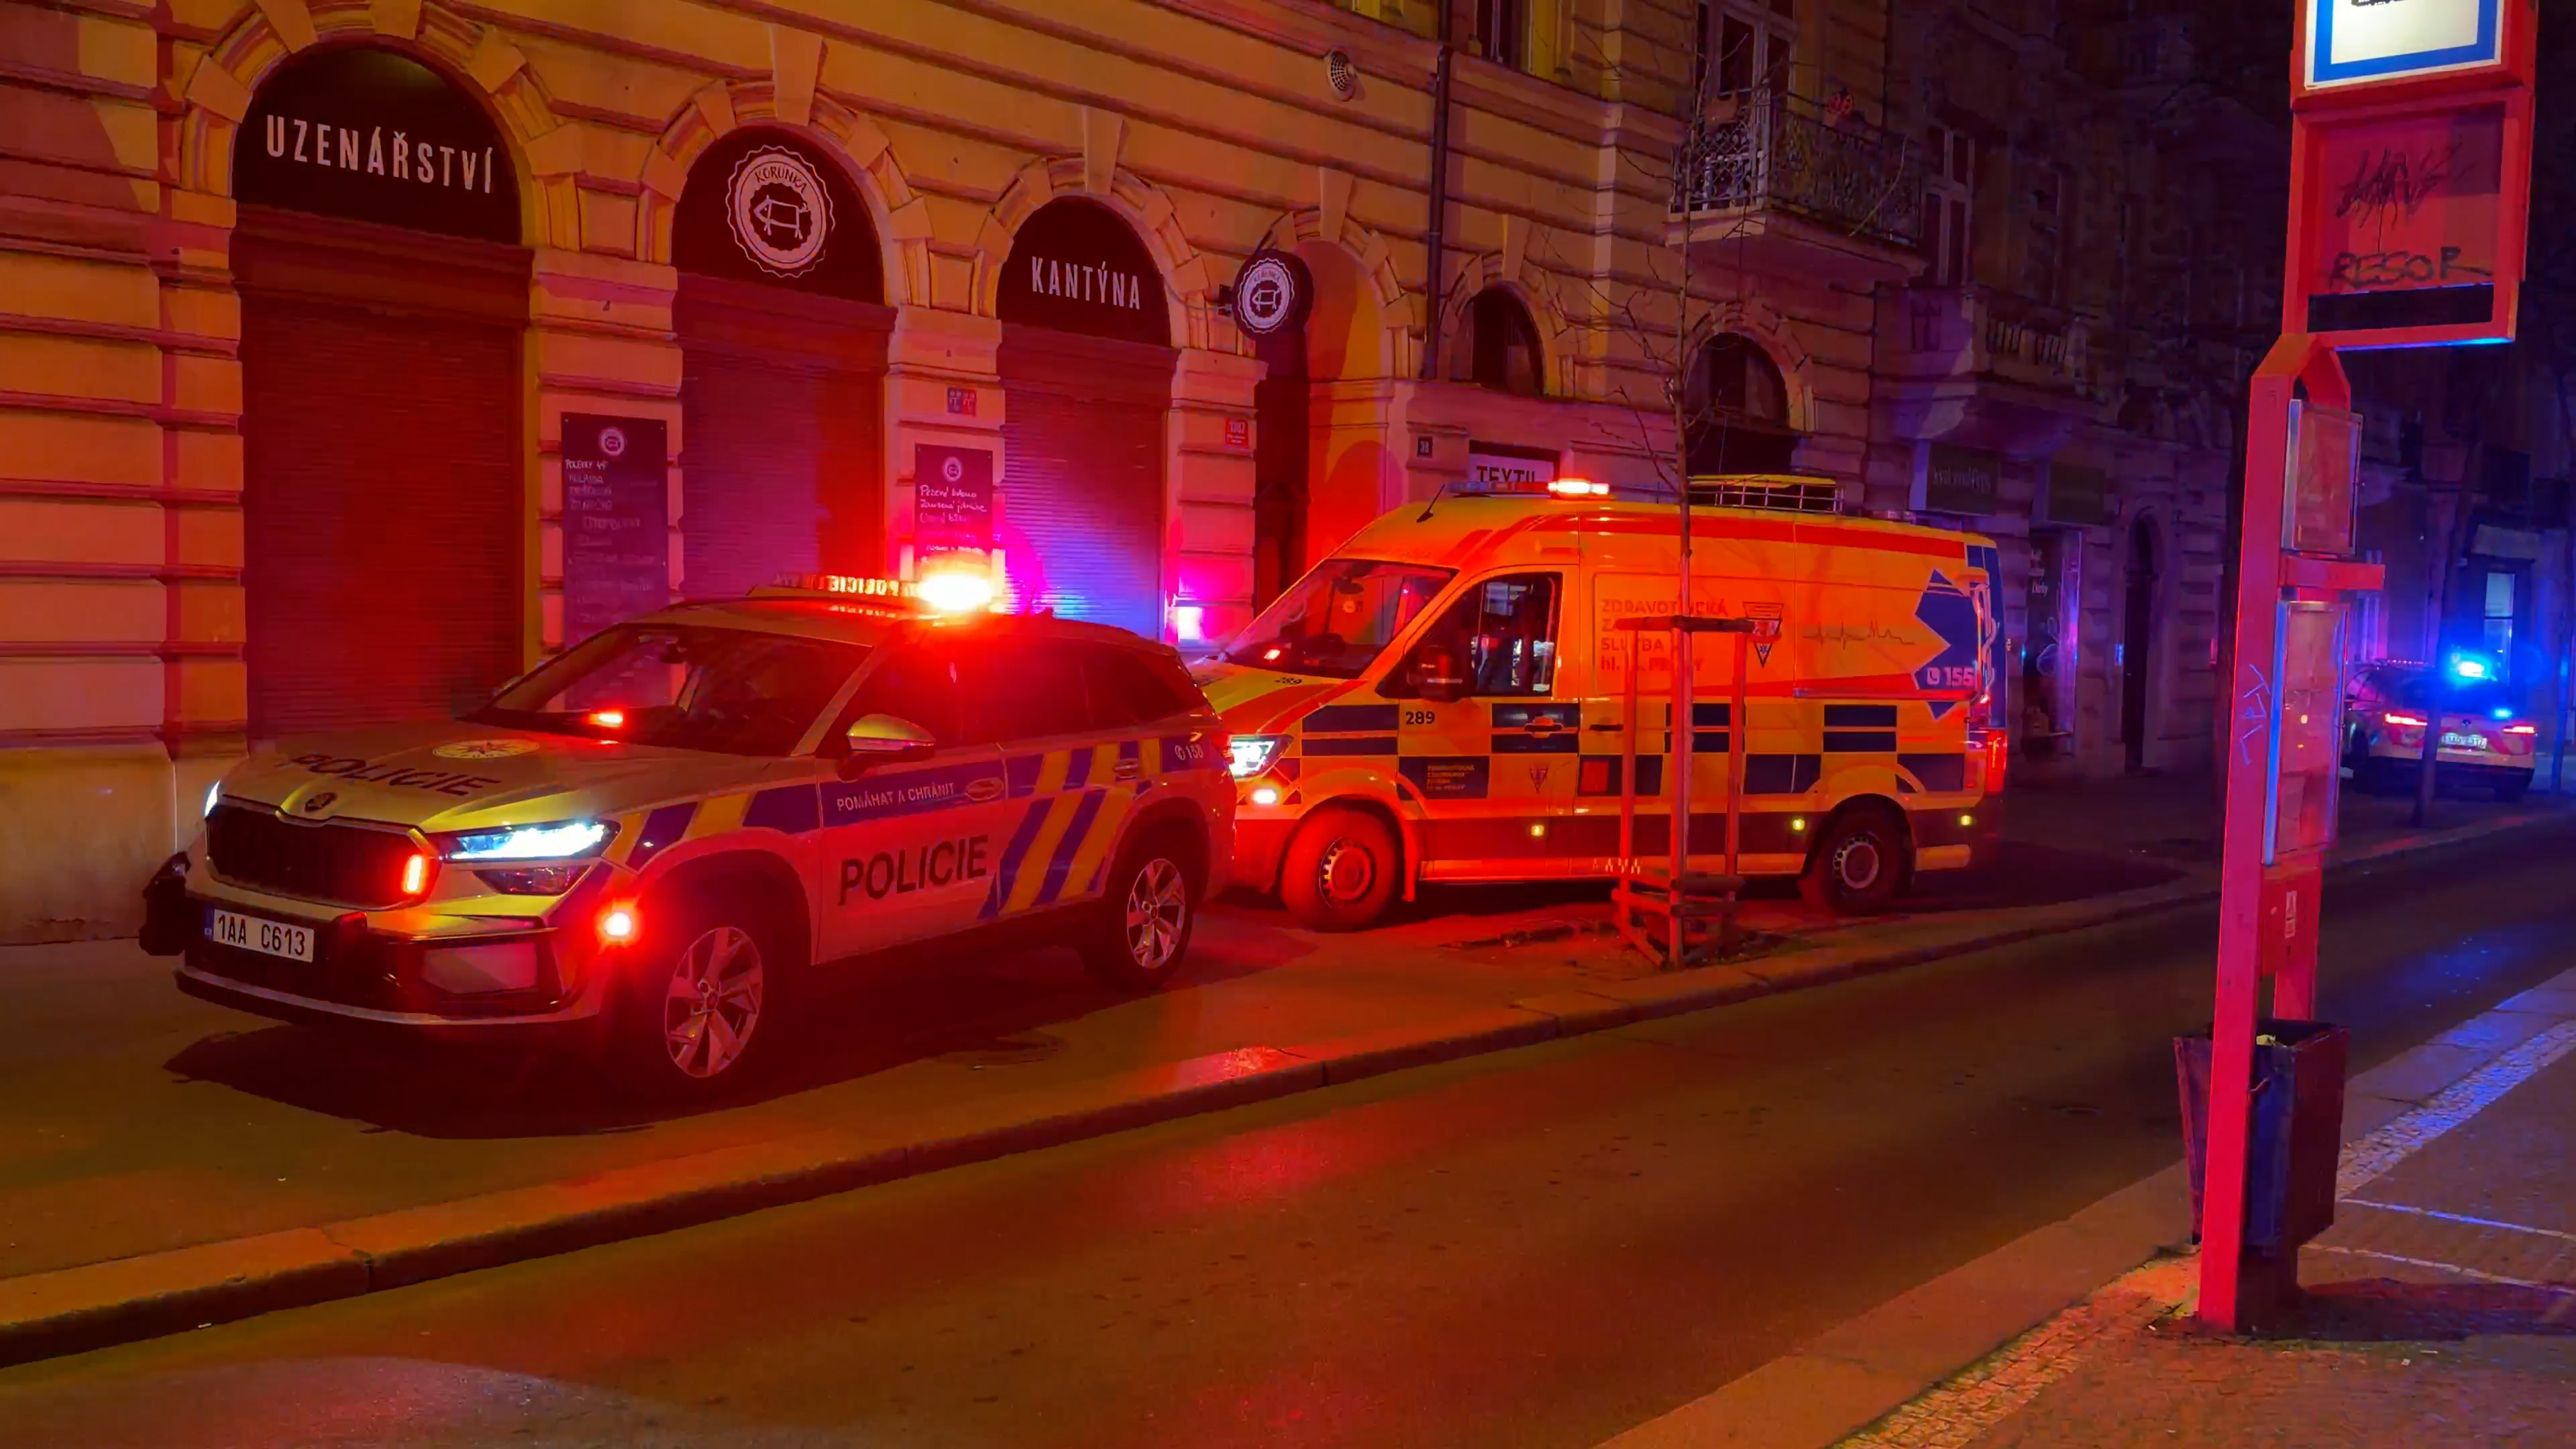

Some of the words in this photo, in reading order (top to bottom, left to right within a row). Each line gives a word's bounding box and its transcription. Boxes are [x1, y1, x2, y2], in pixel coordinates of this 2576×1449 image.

[267, 114, 493, 194] UZENÁŘSTVÍ
[755, 166, 807, 194] KORUNKA
[1032, 256, 1140, 309] KANTÝNA
[1601, 638, 1664, 651] SLUBA
[1274, 676, 1302, 685] 289
[1944, 666, 1975, 686] 155
[1405, 711, 1435, 725] 289
[292, 754, 500, 795] POLICIE
[837, 791, 893, 811] POMÁHAT
[898, 790, 906, 802] A
[908, 782, 953, 801] CHRÁNIT
[839, 835, 989, 906] POLICIE
[218, 914, 246, 945] 1AA
[261, 924, 305, 956] C613
